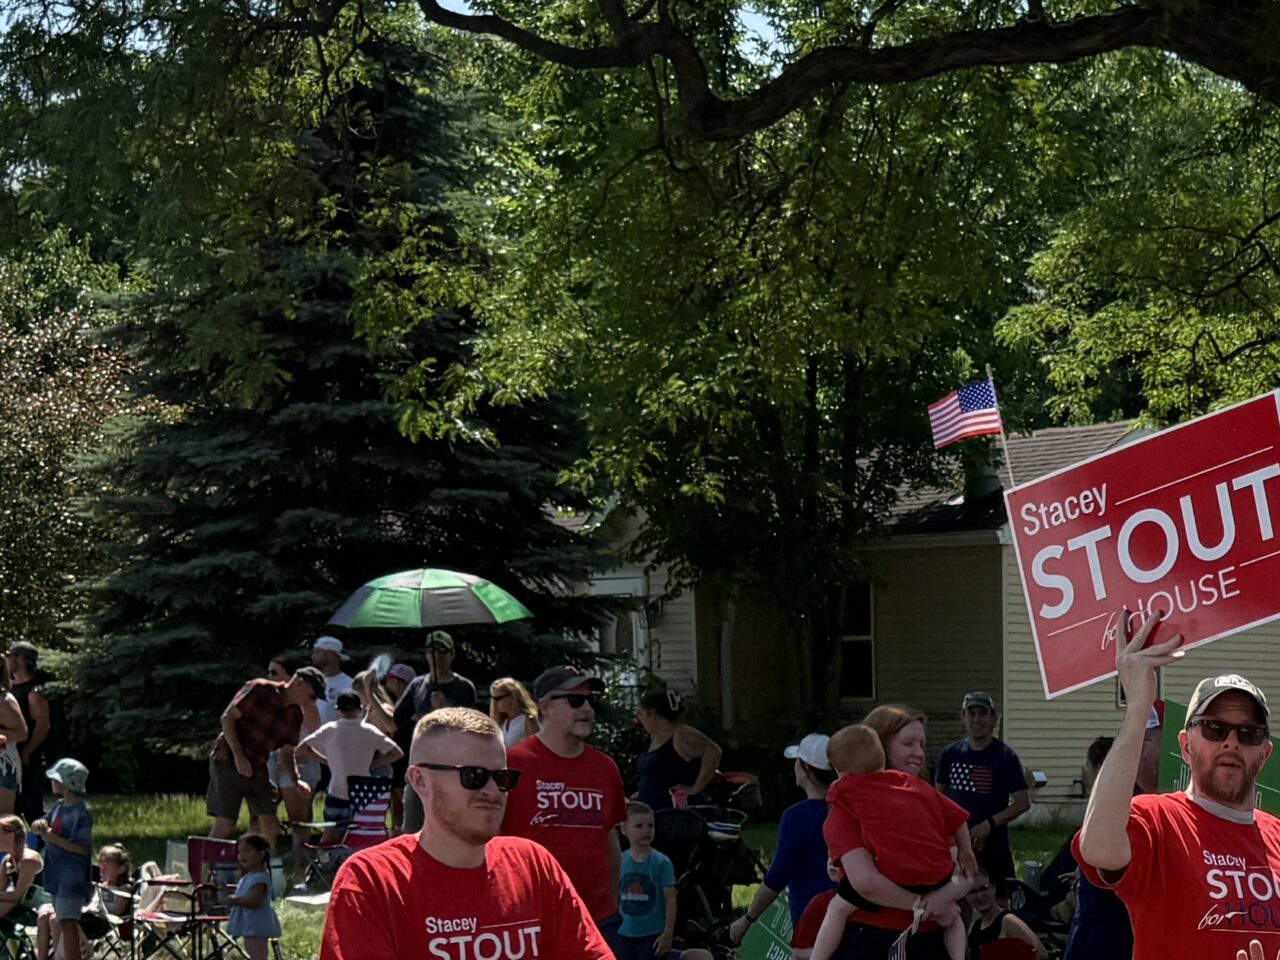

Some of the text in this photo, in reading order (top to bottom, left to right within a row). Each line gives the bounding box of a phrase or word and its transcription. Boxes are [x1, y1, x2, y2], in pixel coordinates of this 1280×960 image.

[1020, 483, 1107, 536] Stacey
[1031, 463, 1280, 619] STOUT
[536, 790, 604, 811] STOUT
[425, 916, 477, 934] Stacey
[1197, 903, 1225, 930] for
